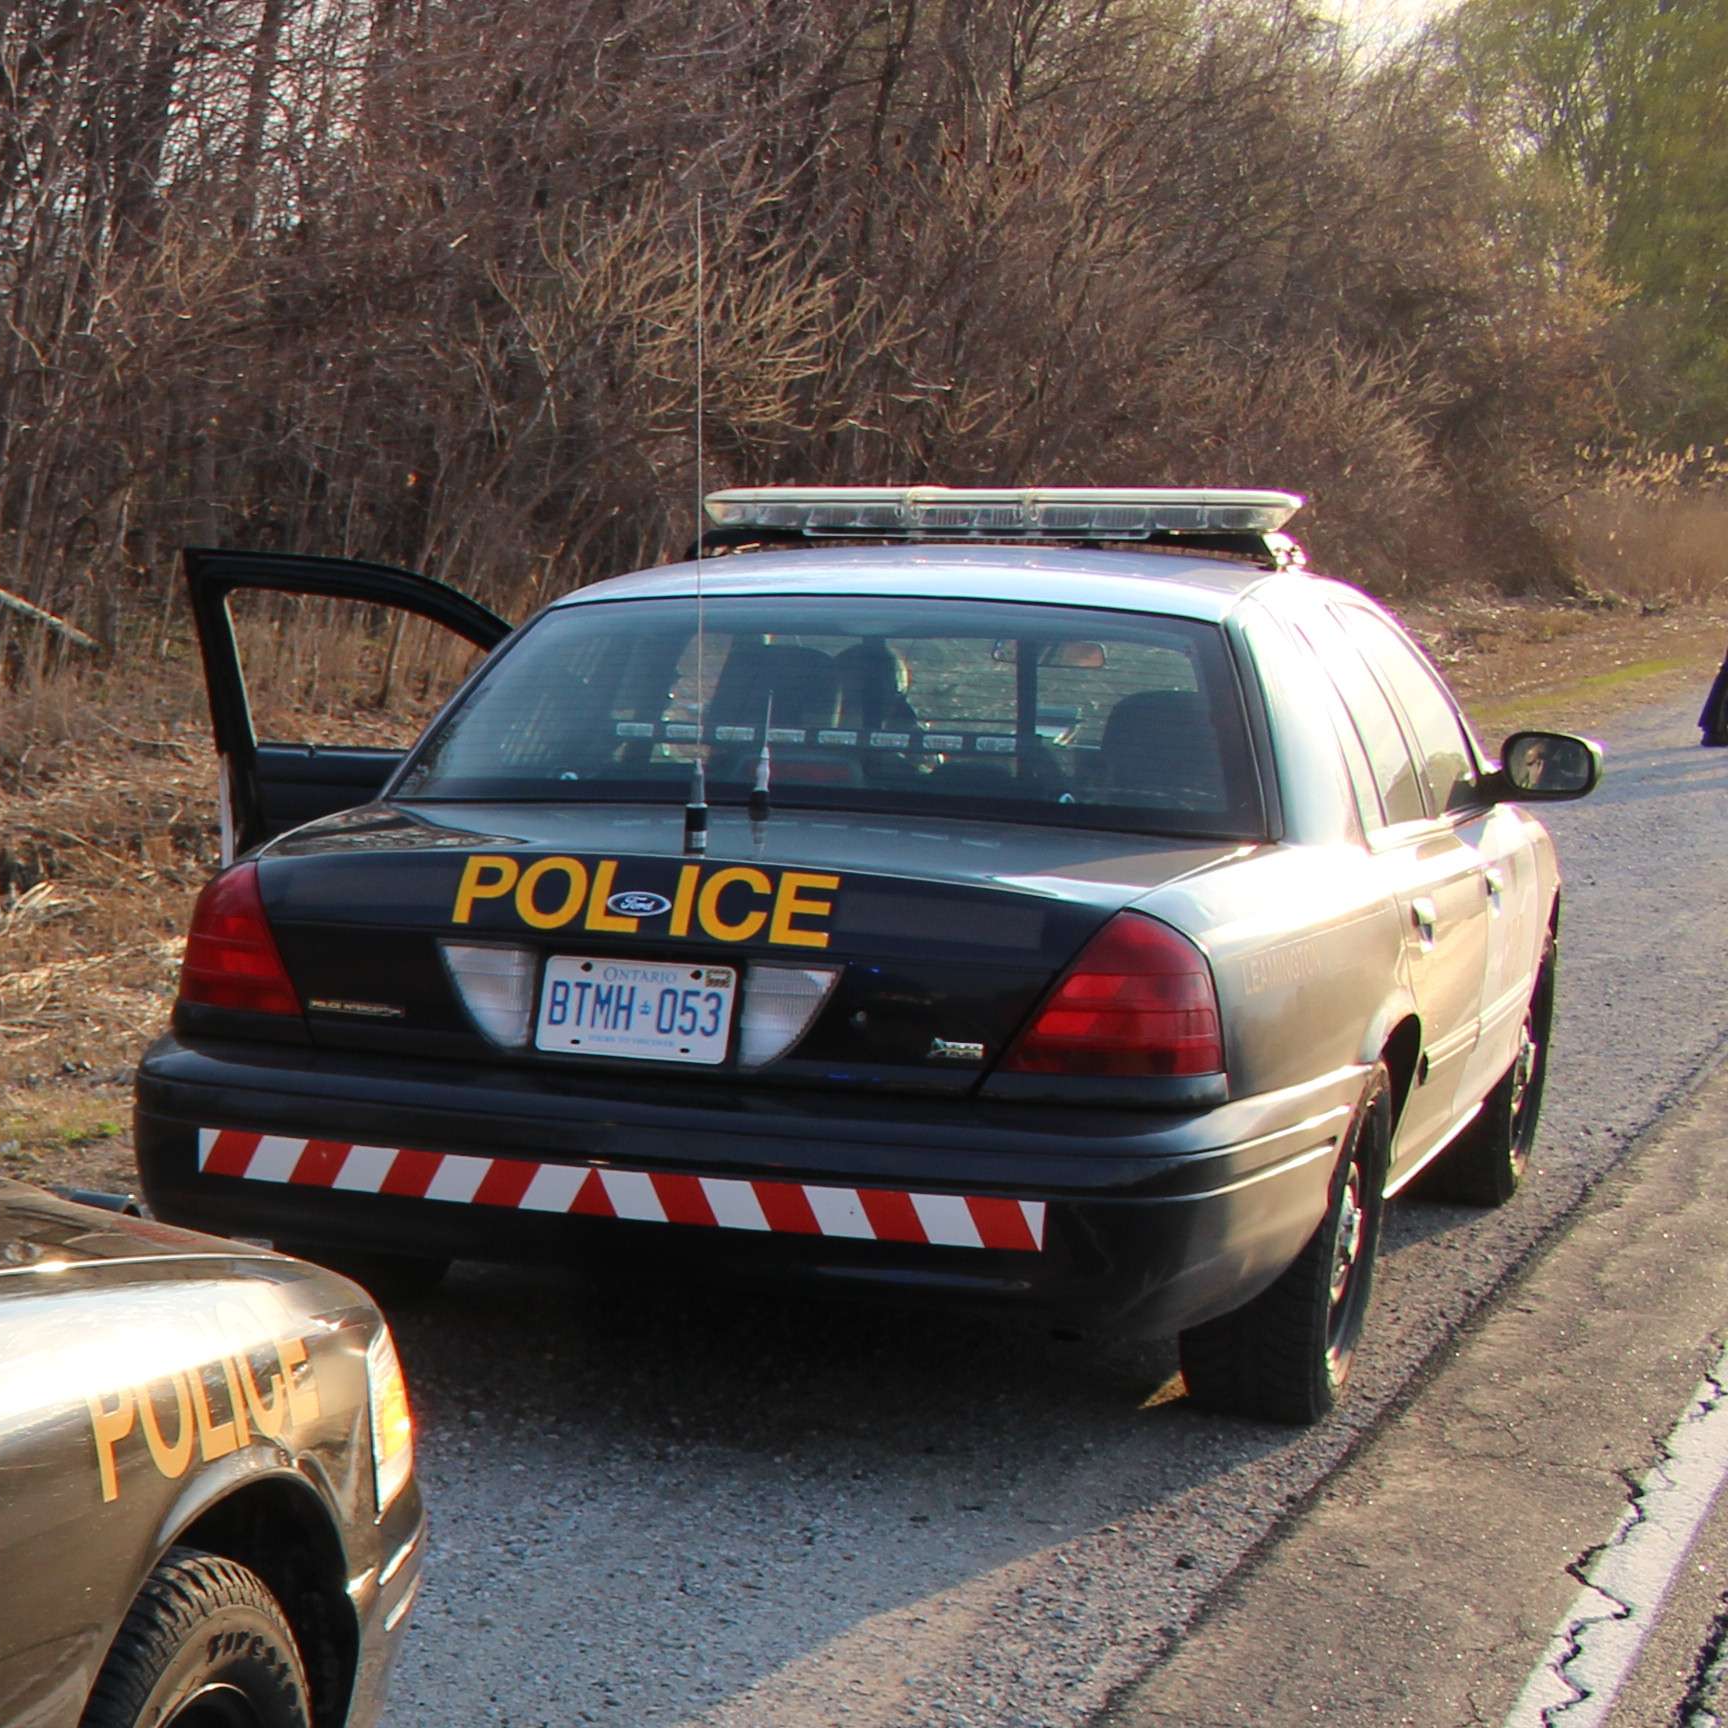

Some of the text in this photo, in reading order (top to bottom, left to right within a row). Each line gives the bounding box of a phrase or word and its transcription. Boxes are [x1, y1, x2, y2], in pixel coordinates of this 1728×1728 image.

[451, 855, 841, 948] POLICE
[548, 980, 723, 1038] BTMH 053
[85, 1332, 321, 1504] POLICE
